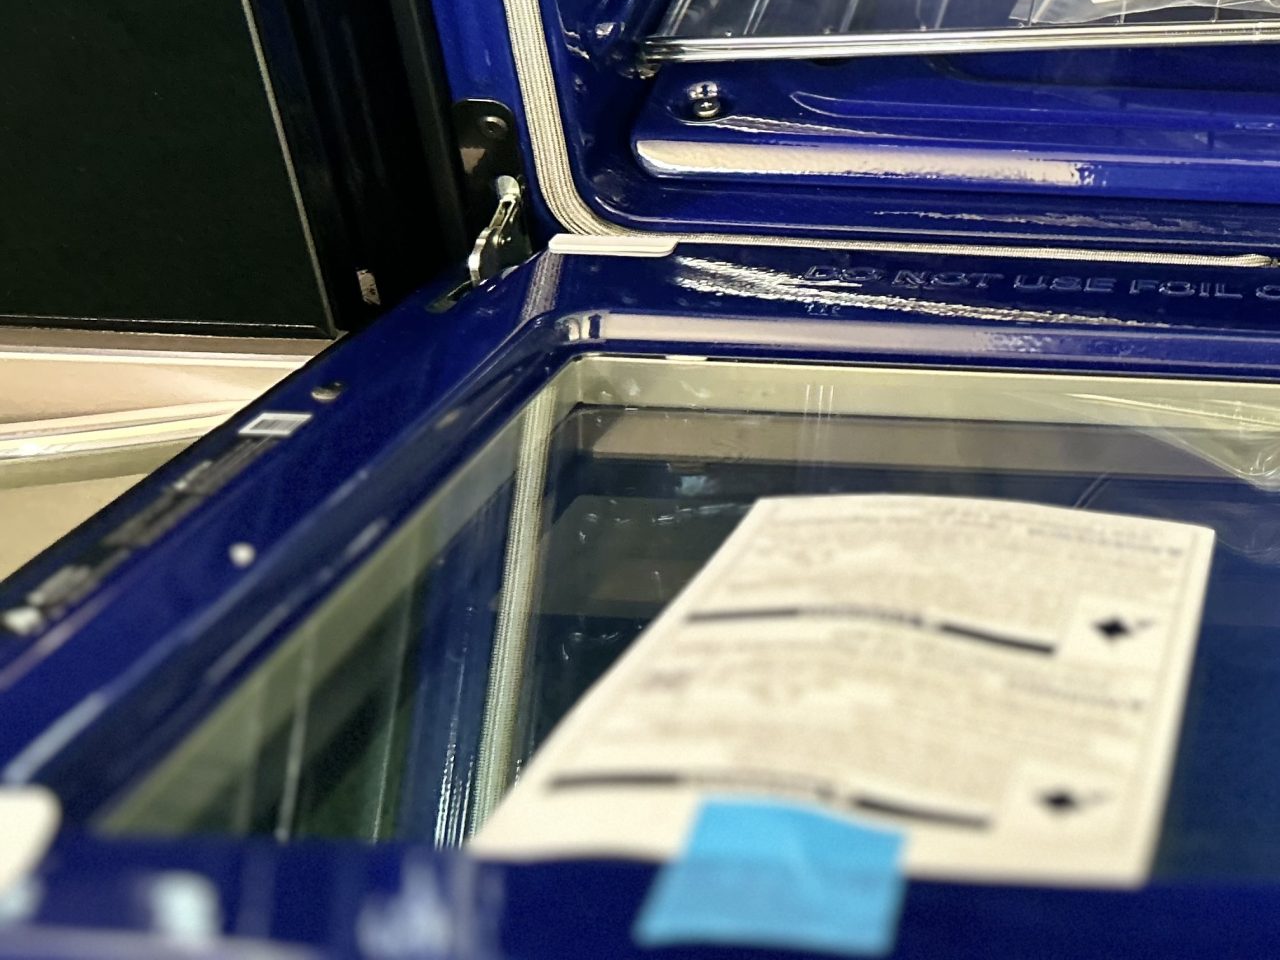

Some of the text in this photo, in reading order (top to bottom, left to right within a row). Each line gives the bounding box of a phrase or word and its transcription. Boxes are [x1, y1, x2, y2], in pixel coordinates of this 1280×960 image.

[802, 266, 882, 283] DO
[892, 270, 1004, 290] NOT
[1013, 274, 1116, 293] USE
[1129, 278, 1243, 299] FOIL
